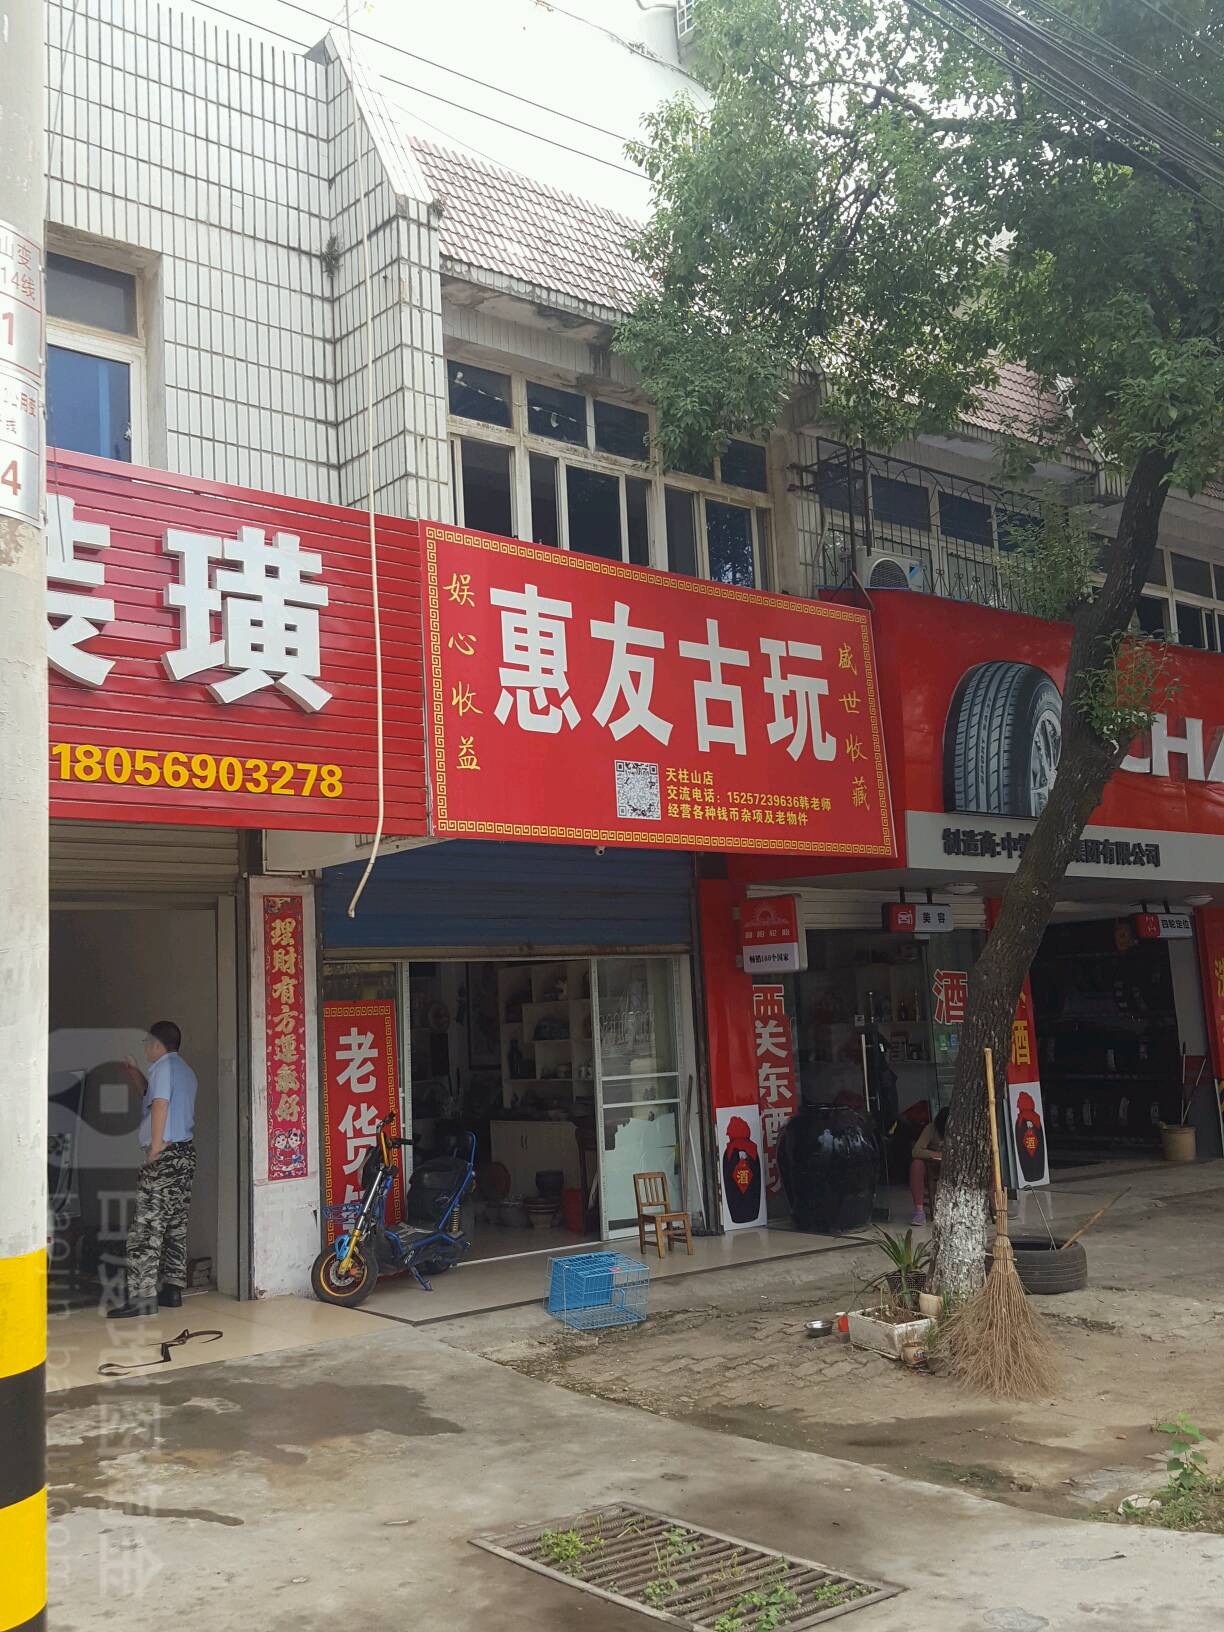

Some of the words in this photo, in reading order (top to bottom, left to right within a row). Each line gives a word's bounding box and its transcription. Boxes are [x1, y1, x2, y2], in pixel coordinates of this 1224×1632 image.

[442, 572, 484, 771] 娱心收益
[489, 583, 837, 763] 惠友古玩
[52, 743, 343, 798] 18056903278
[665, 767, 714, 786] 天柱山店
[667, 803, 809, 827] 经营各种钱币杂项及老物件
